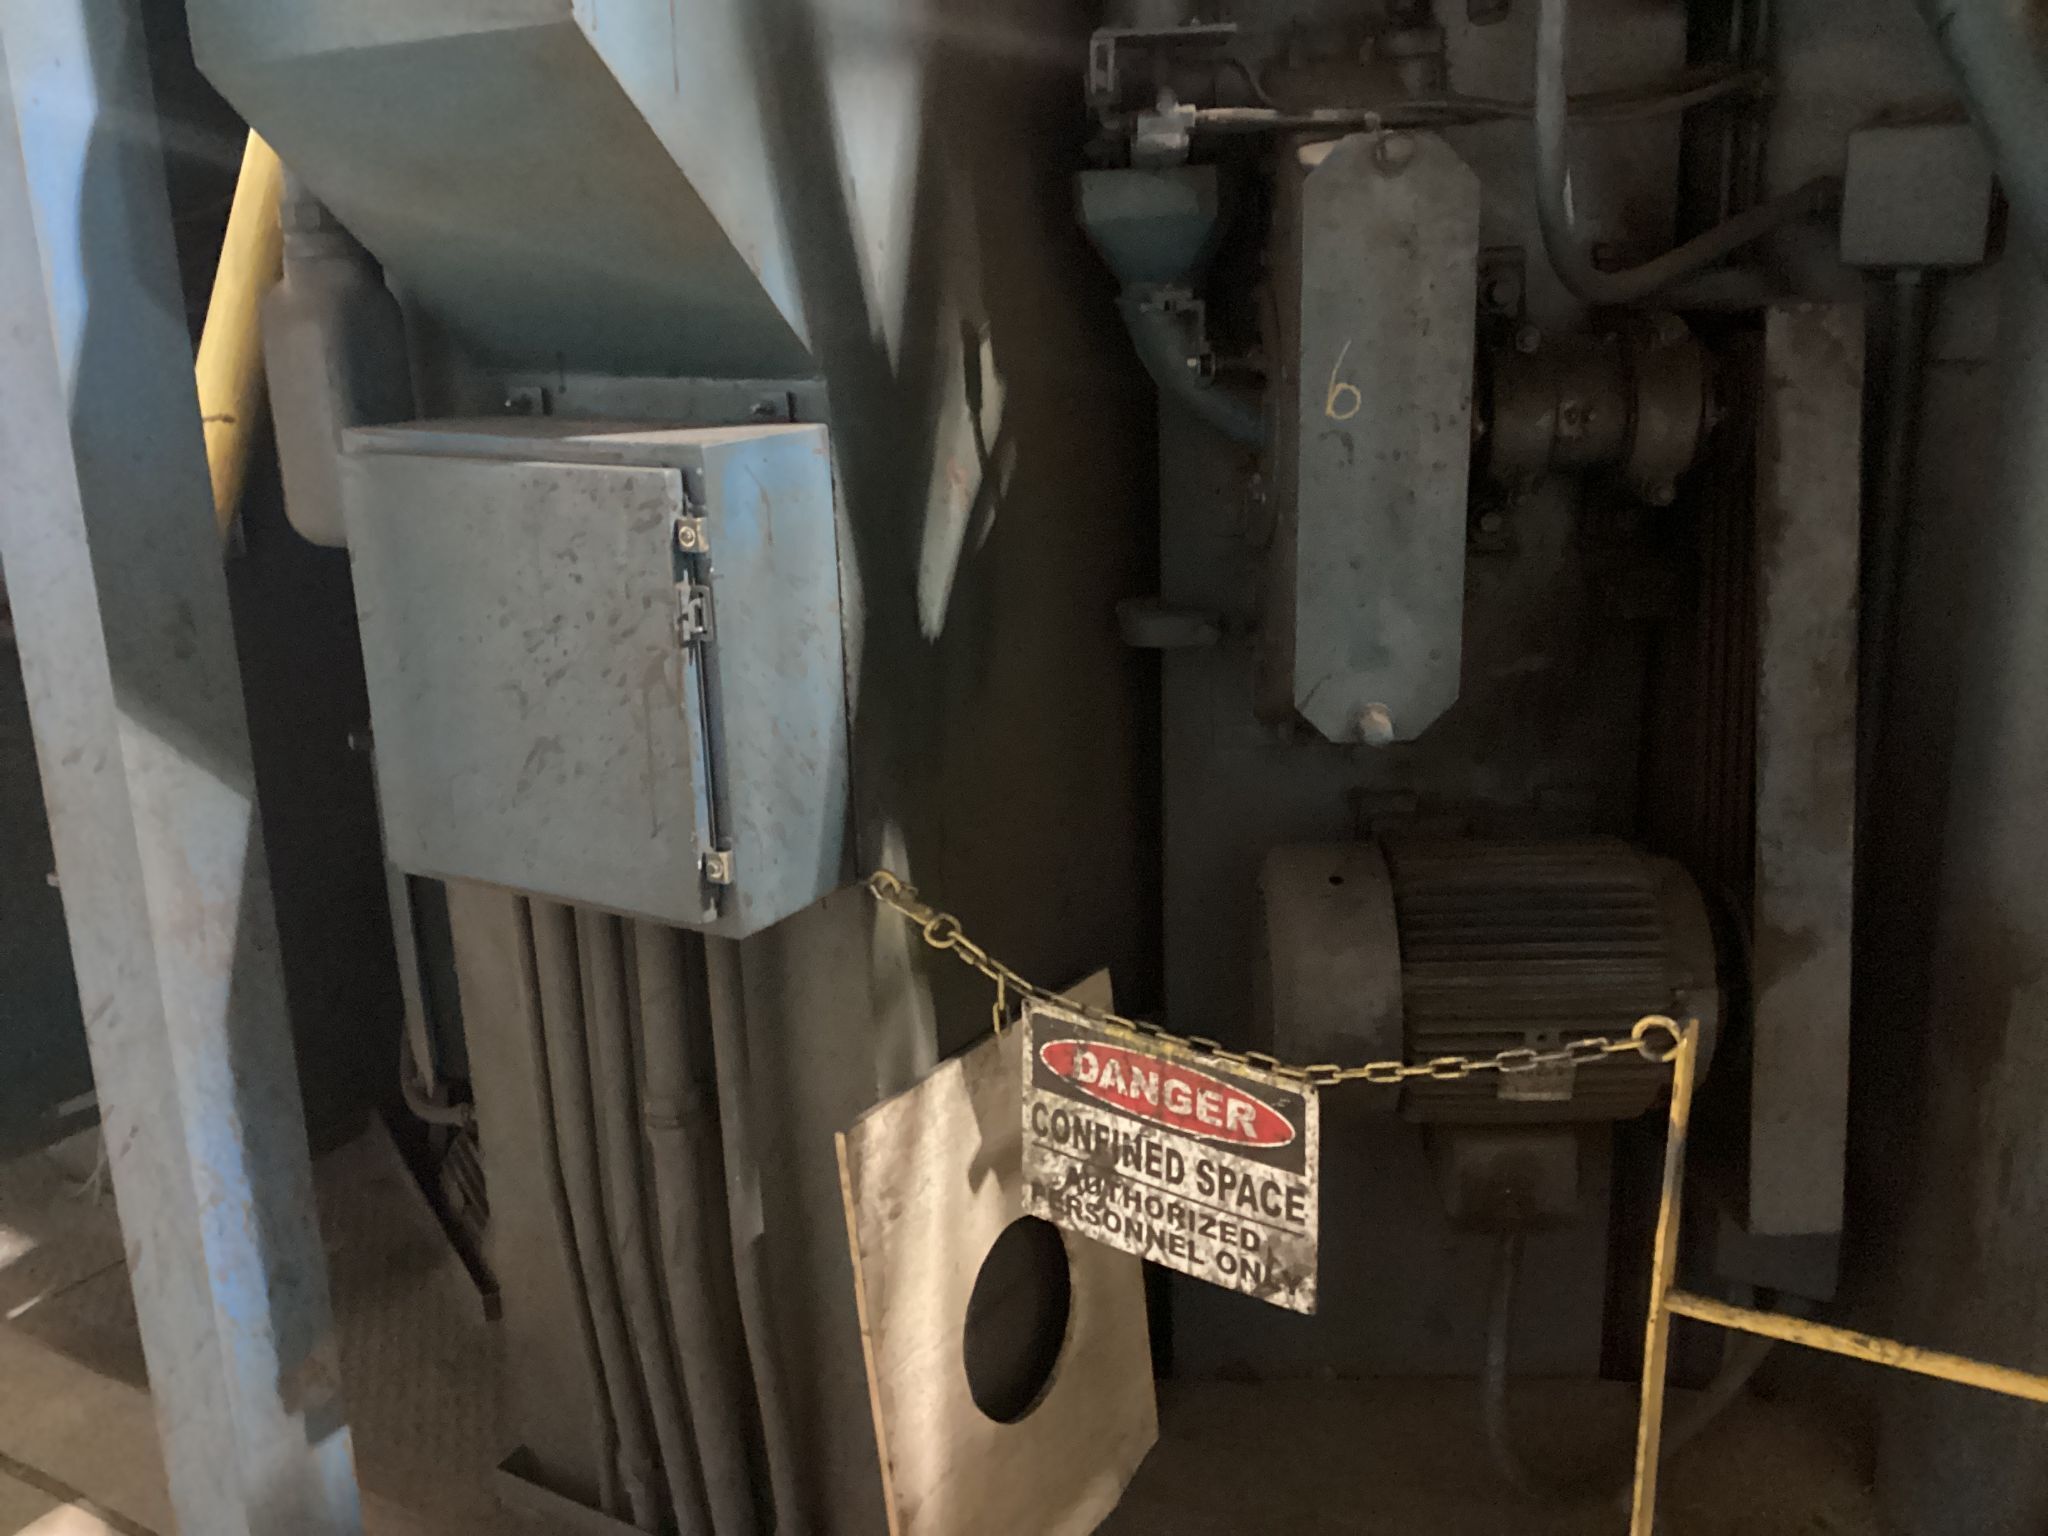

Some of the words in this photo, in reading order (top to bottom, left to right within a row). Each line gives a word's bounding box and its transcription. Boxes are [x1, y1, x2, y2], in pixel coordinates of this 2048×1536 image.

[1325, 338, 1362, 420] 6
[1072, 1049, 1257, 1139] DANGER
[1031, 1102, 1185, 1186] CONFINED
[1196, 1159, 1306, 1226] SPACE
[1031, 1182, 1205, 1265] PERSONNEL
[1065, 1165, 1260, 1252] AUTHORIZED
